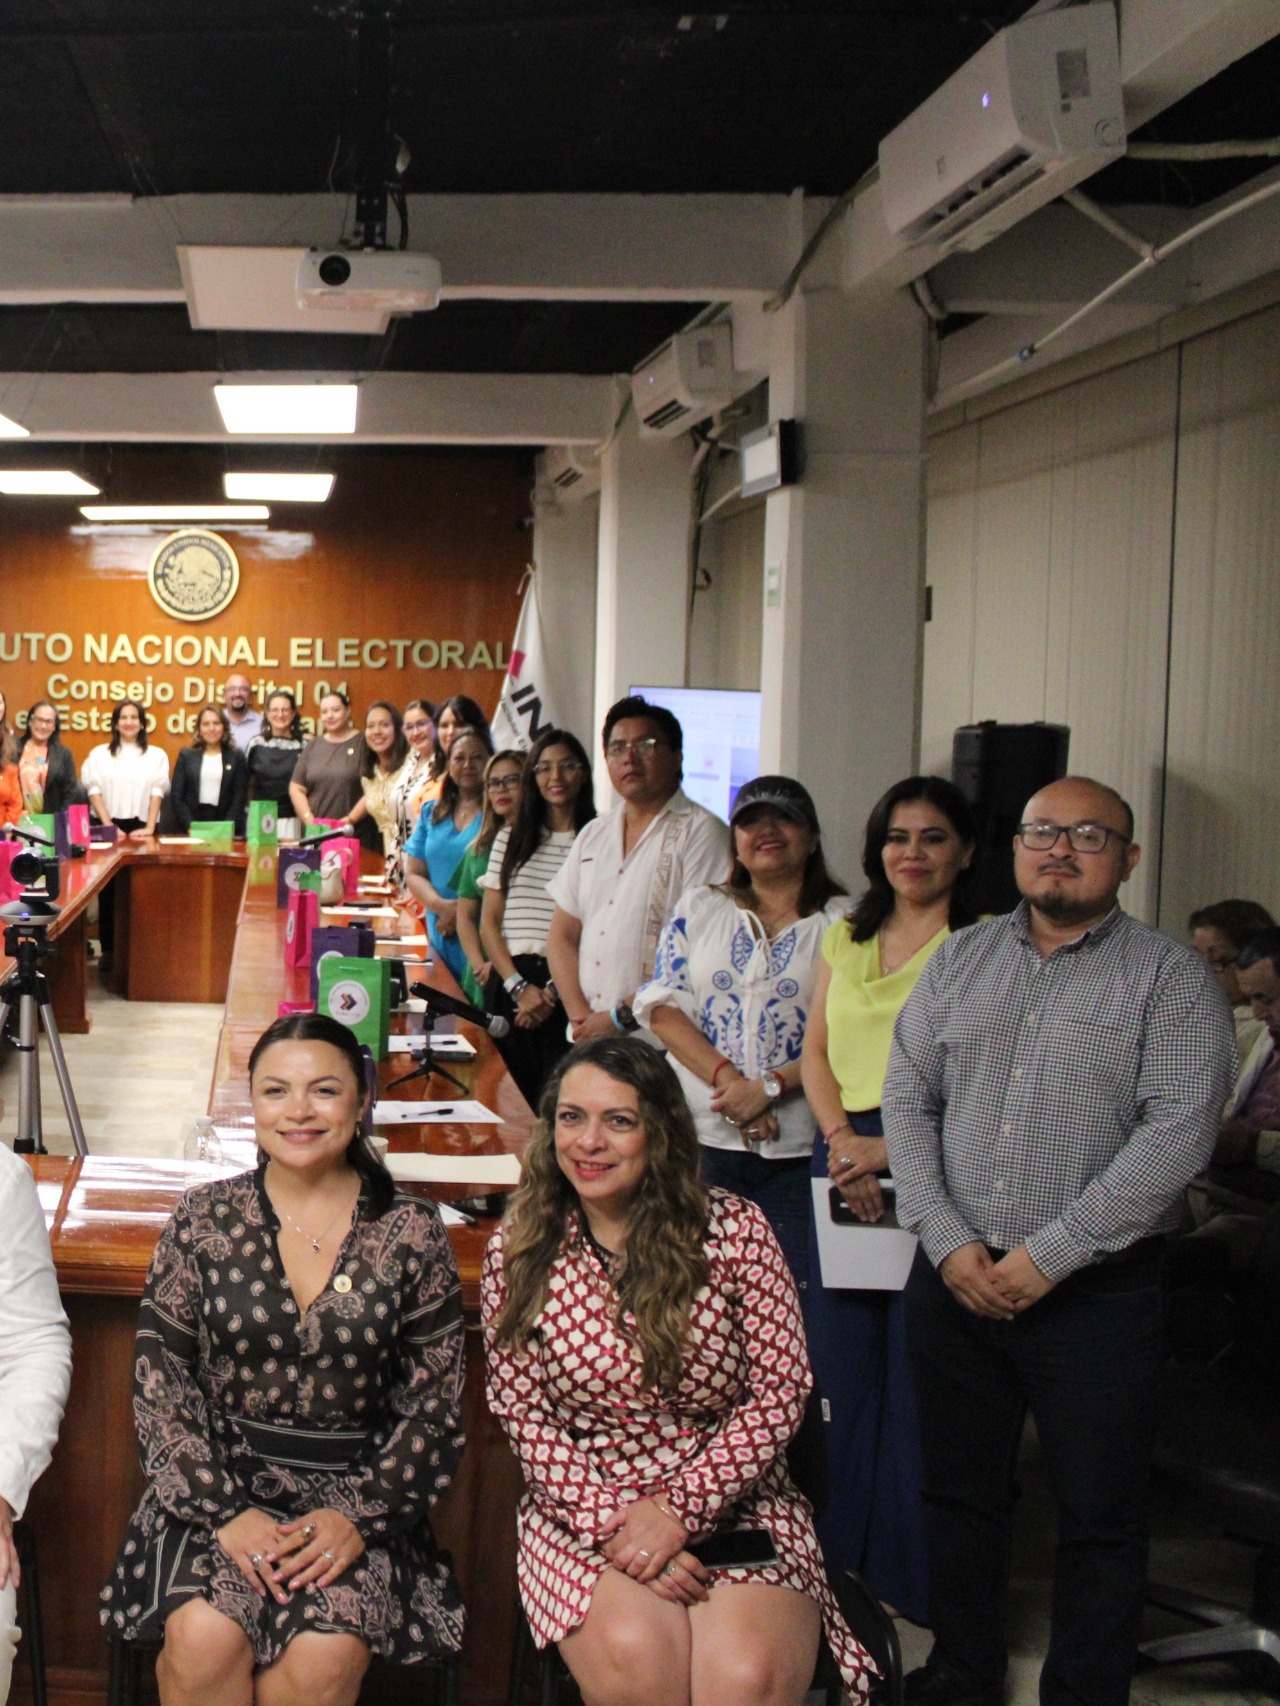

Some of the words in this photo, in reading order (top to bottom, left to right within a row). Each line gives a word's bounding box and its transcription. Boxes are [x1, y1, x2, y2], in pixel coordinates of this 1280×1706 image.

[83, 633, 279, 667] NACIONAL
[290, 637, 508, 670] ELECTORAL
[47, 673, 174, 708] Consejo
